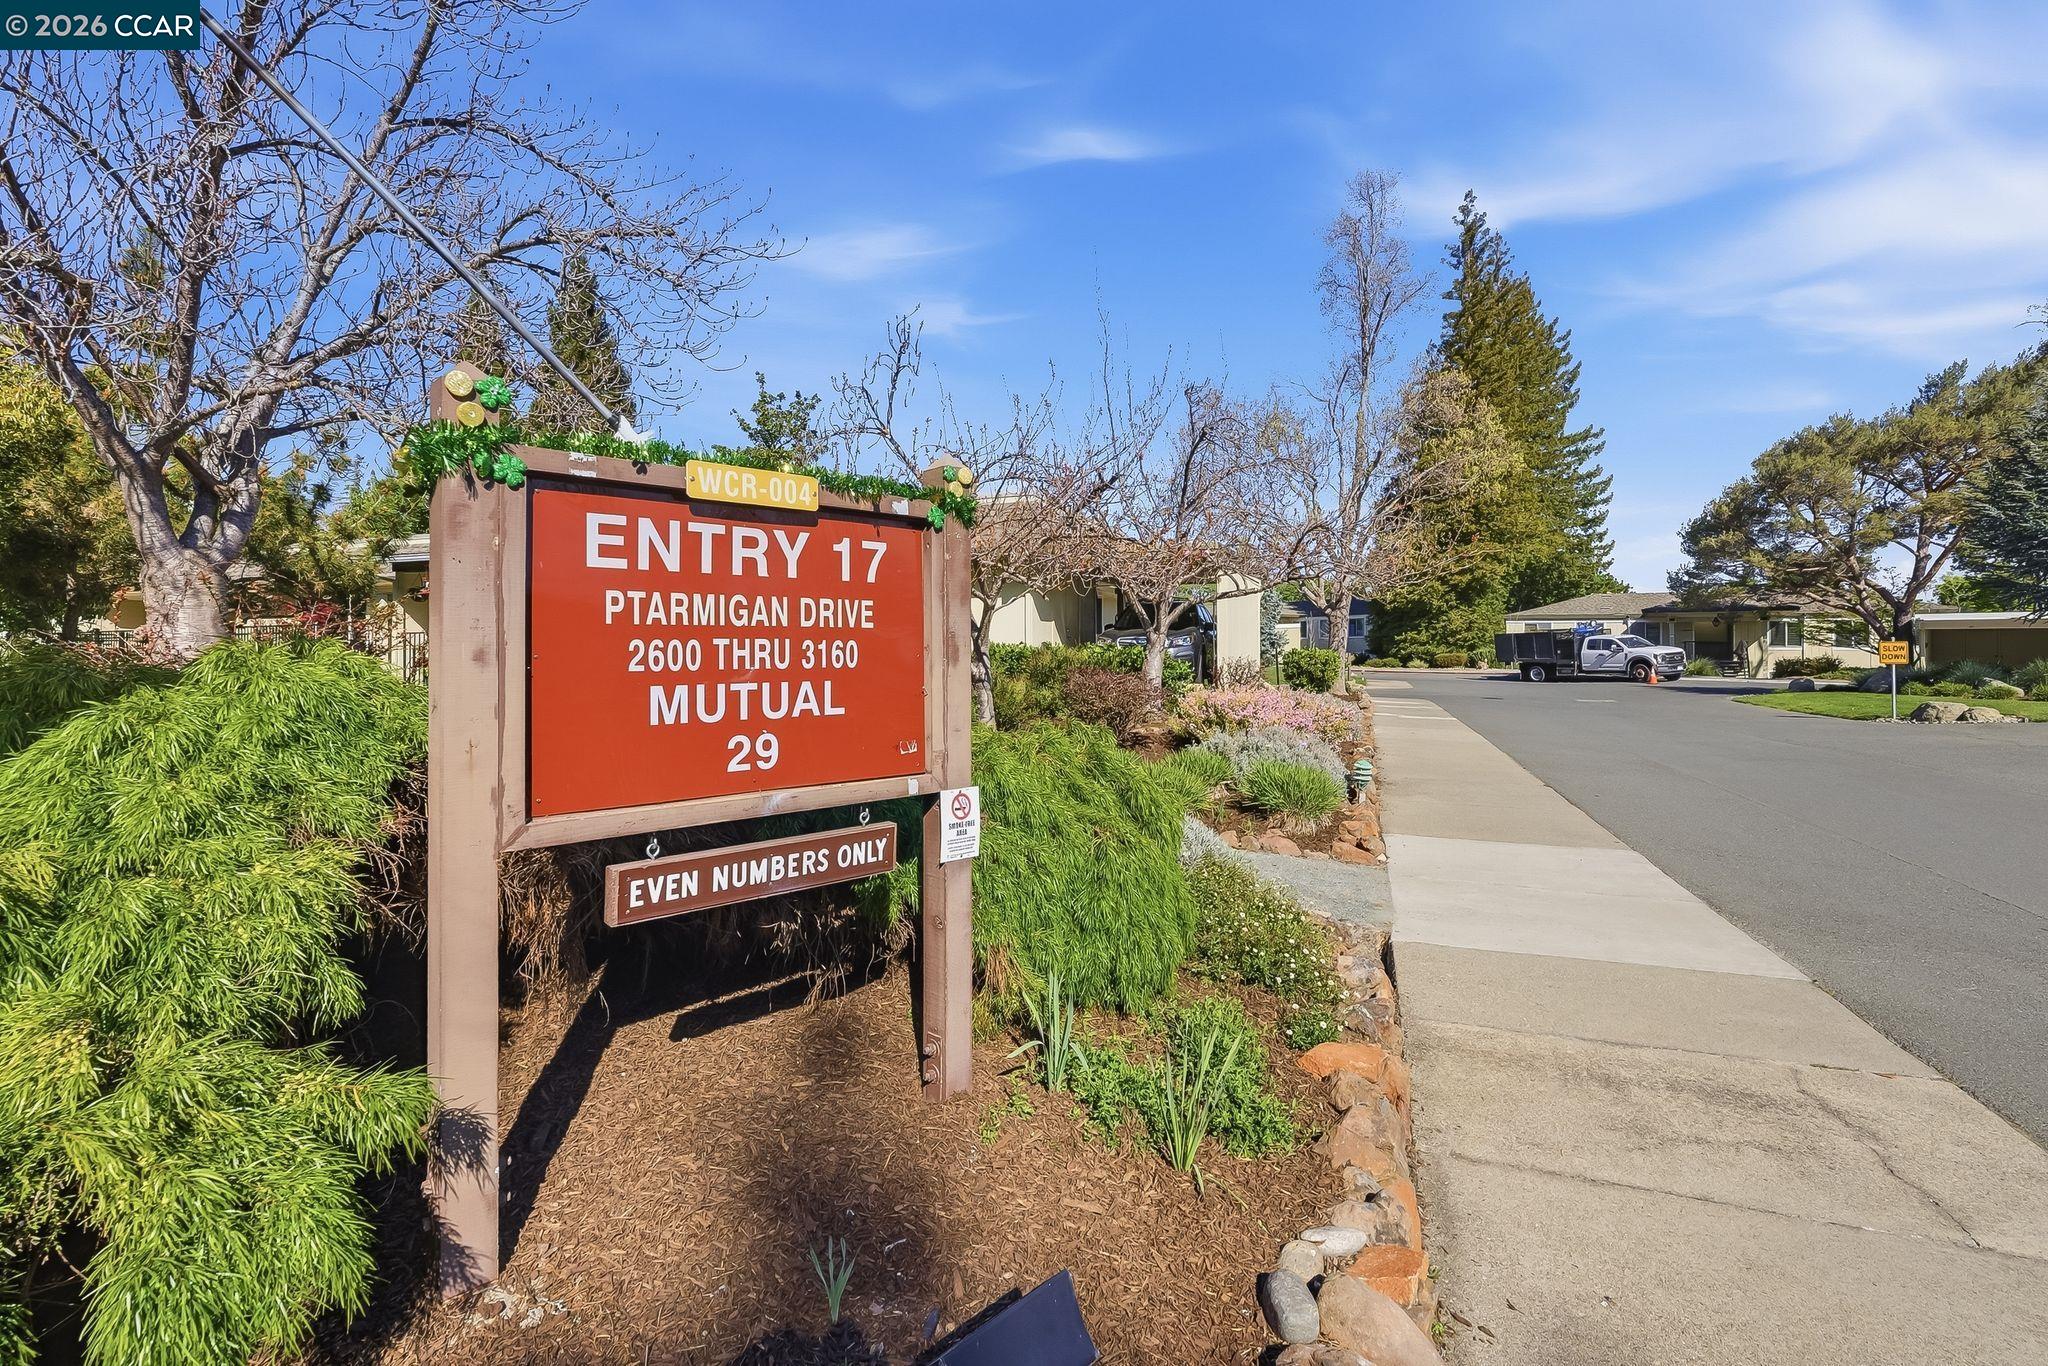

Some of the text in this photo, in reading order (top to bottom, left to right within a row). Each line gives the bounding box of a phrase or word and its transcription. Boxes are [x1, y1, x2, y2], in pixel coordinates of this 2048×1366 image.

[696, 466, 812, 506] WCR-004
[585, 512, 888, 584] ENTRY 17
[604, 590, 875, 629] PTARMIGAN DRIVE
[627, 638, 859, 673] 2600 THRU 3160
[649, 680, 846, 727] MUTUAL
[726, 733, 780, 774] 29
[629, 836, 889, 909] EVEN NUMBERS ONLY
